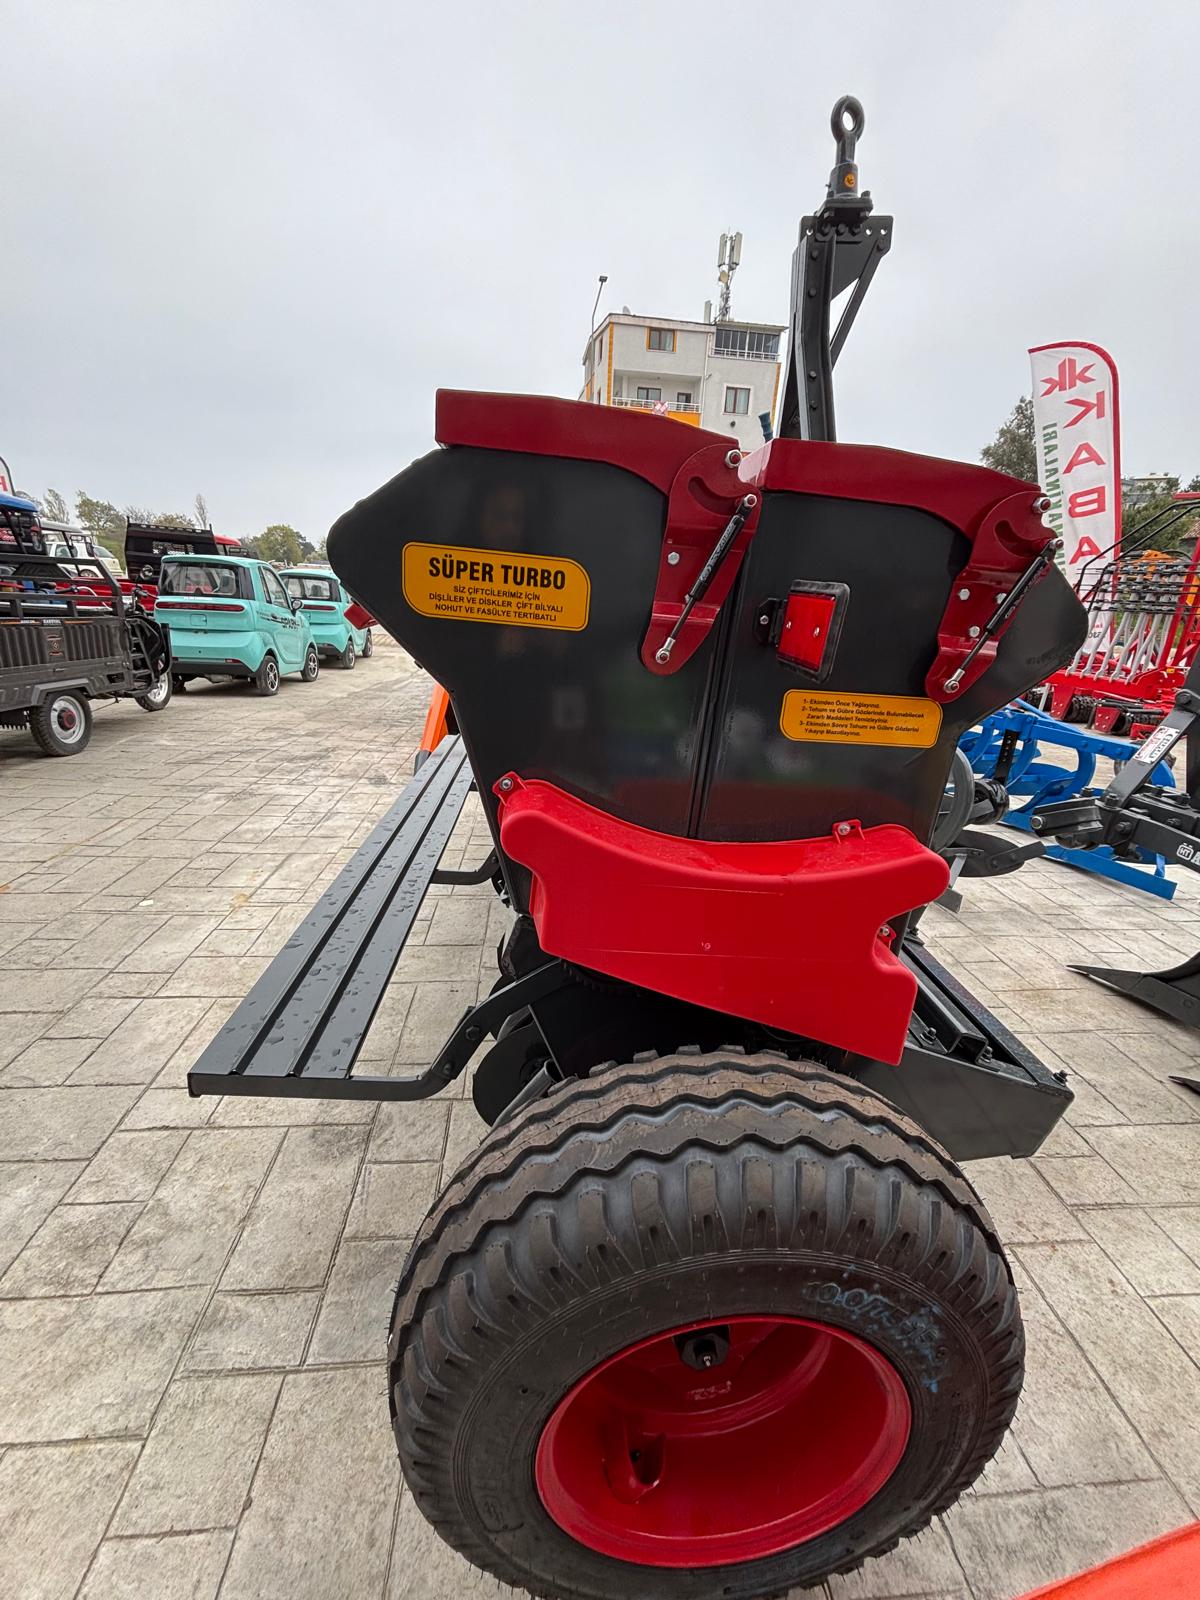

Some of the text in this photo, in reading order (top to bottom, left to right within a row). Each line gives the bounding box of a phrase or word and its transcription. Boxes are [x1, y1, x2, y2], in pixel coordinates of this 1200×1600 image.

[428, 554, 566, 590] SÜPER TURBO
[453, 584, 466, 593] SİZ
[524, 591, 541, 601] İÇİN
[429, 592, 465, 603] DİŞLİLER
[478, 597, 513, 608] DİSKLER
[516, 601, 533, 610] ÇİFT
[535, 603, 564, 613] BİLYALI
[435, 603, 557, 621] NOHUT VE FASÜLYE TERTİBATLI
